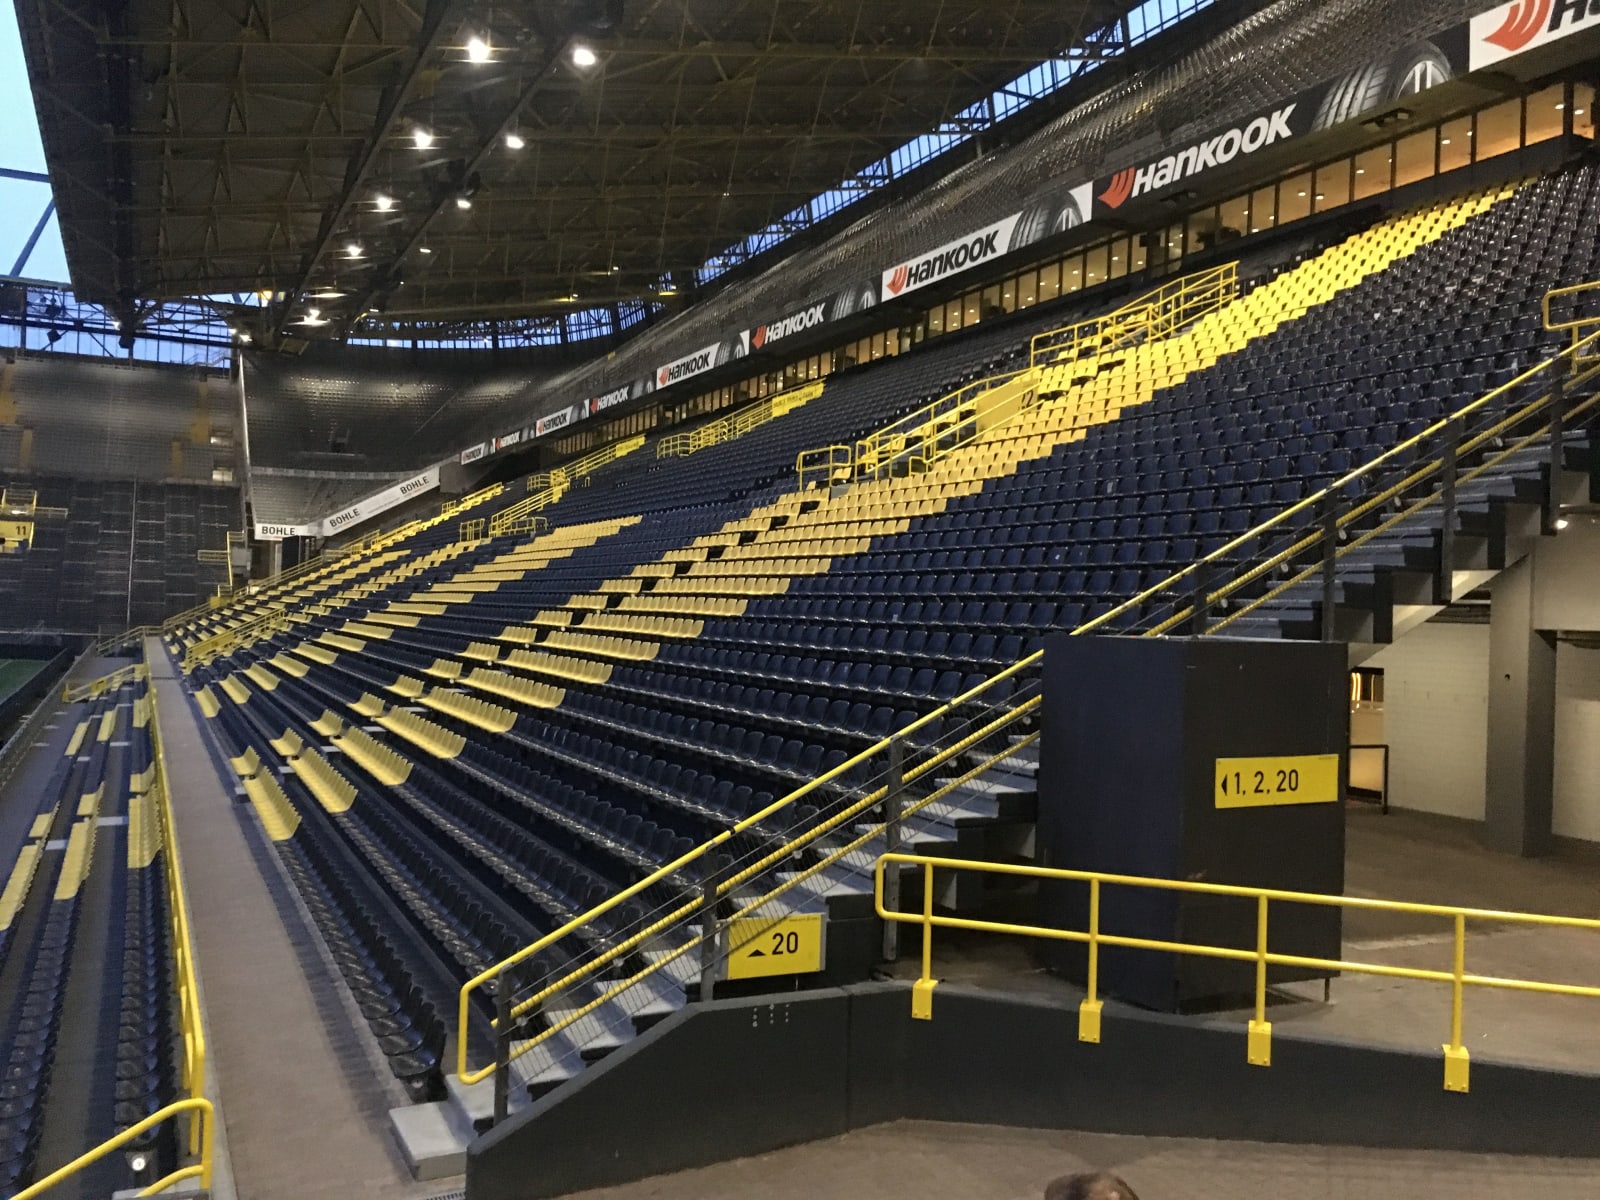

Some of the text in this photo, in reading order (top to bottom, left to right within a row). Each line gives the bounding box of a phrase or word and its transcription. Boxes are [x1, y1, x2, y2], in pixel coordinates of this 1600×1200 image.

[1547, 0, 1600, 33] H
[399, 476, 430, 495] BOHLE
[329, 508, 361, 528] BOHLE
[16, 525, 26, 536] 11
[261, 526, 296, 536] BOHLE
[1234, 769, 1299, 796] 1, 2, 20
[772, 931, 799, 955] 20
